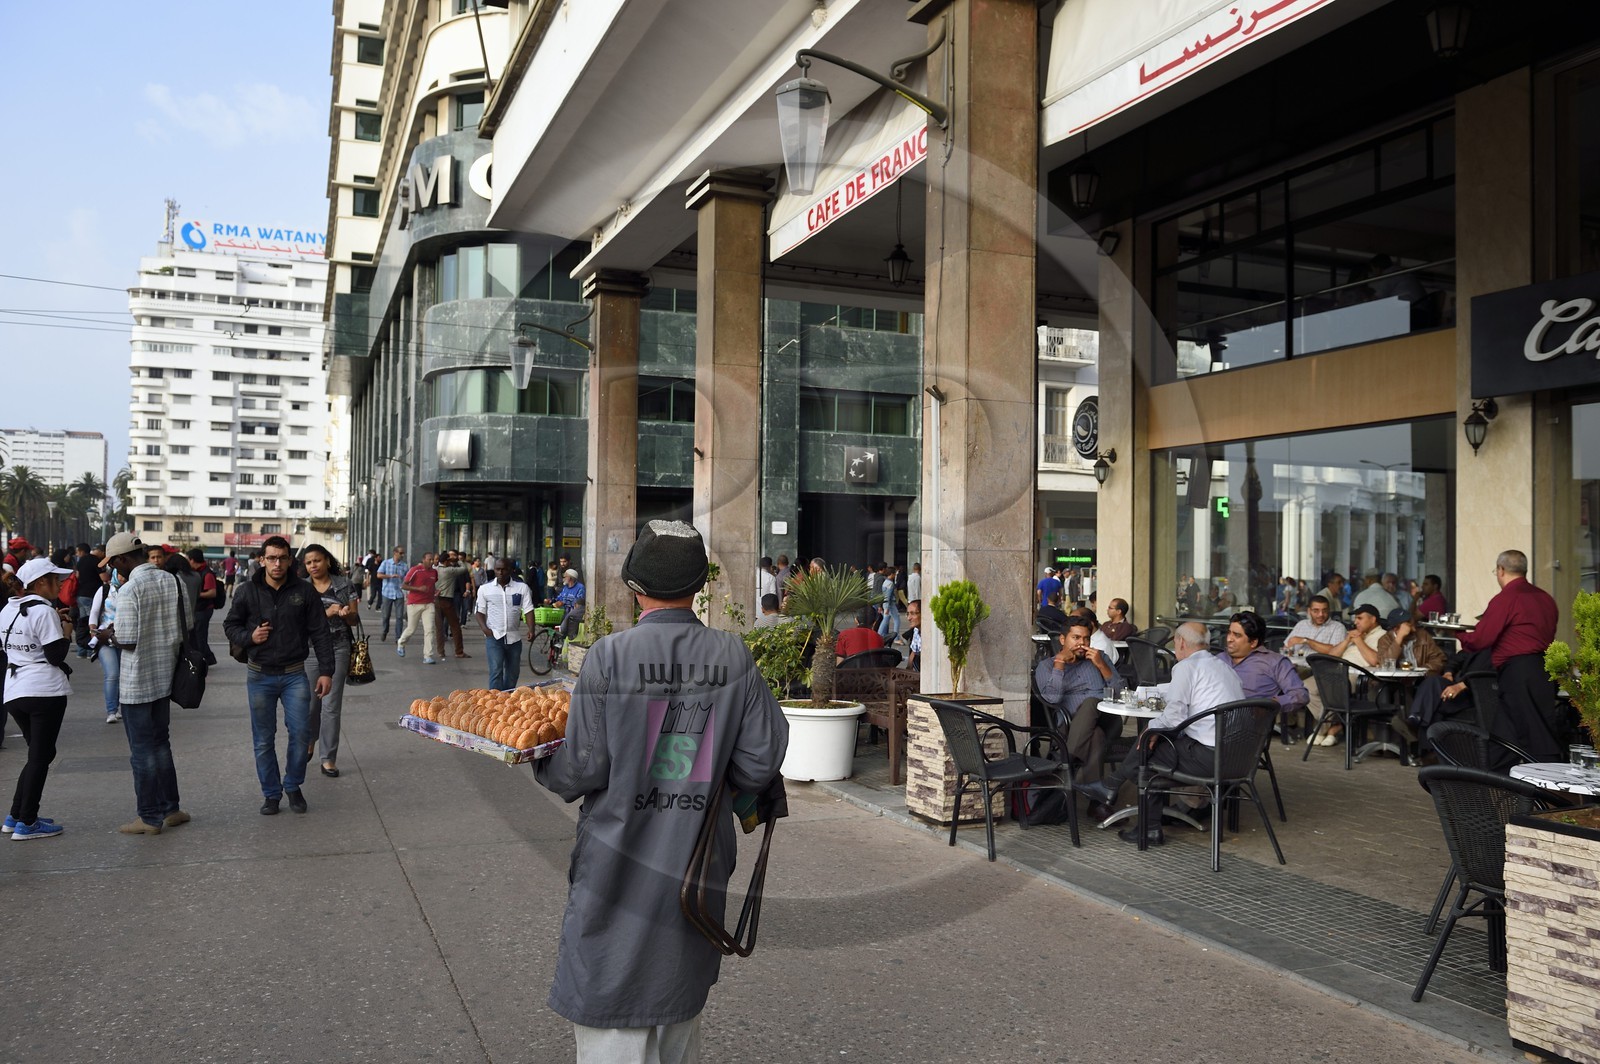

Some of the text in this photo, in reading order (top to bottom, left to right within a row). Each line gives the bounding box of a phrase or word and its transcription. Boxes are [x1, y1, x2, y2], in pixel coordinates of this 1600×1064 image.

[1139, 0, 1298, 85] رنسا
[807, 125, 928, 232] CAFE DE FRANC
[213, 223, 327, 245] RMA WATANY
[1523, 297, 1600, 362] Ca
[636, 663, 728, 694] سبريس
